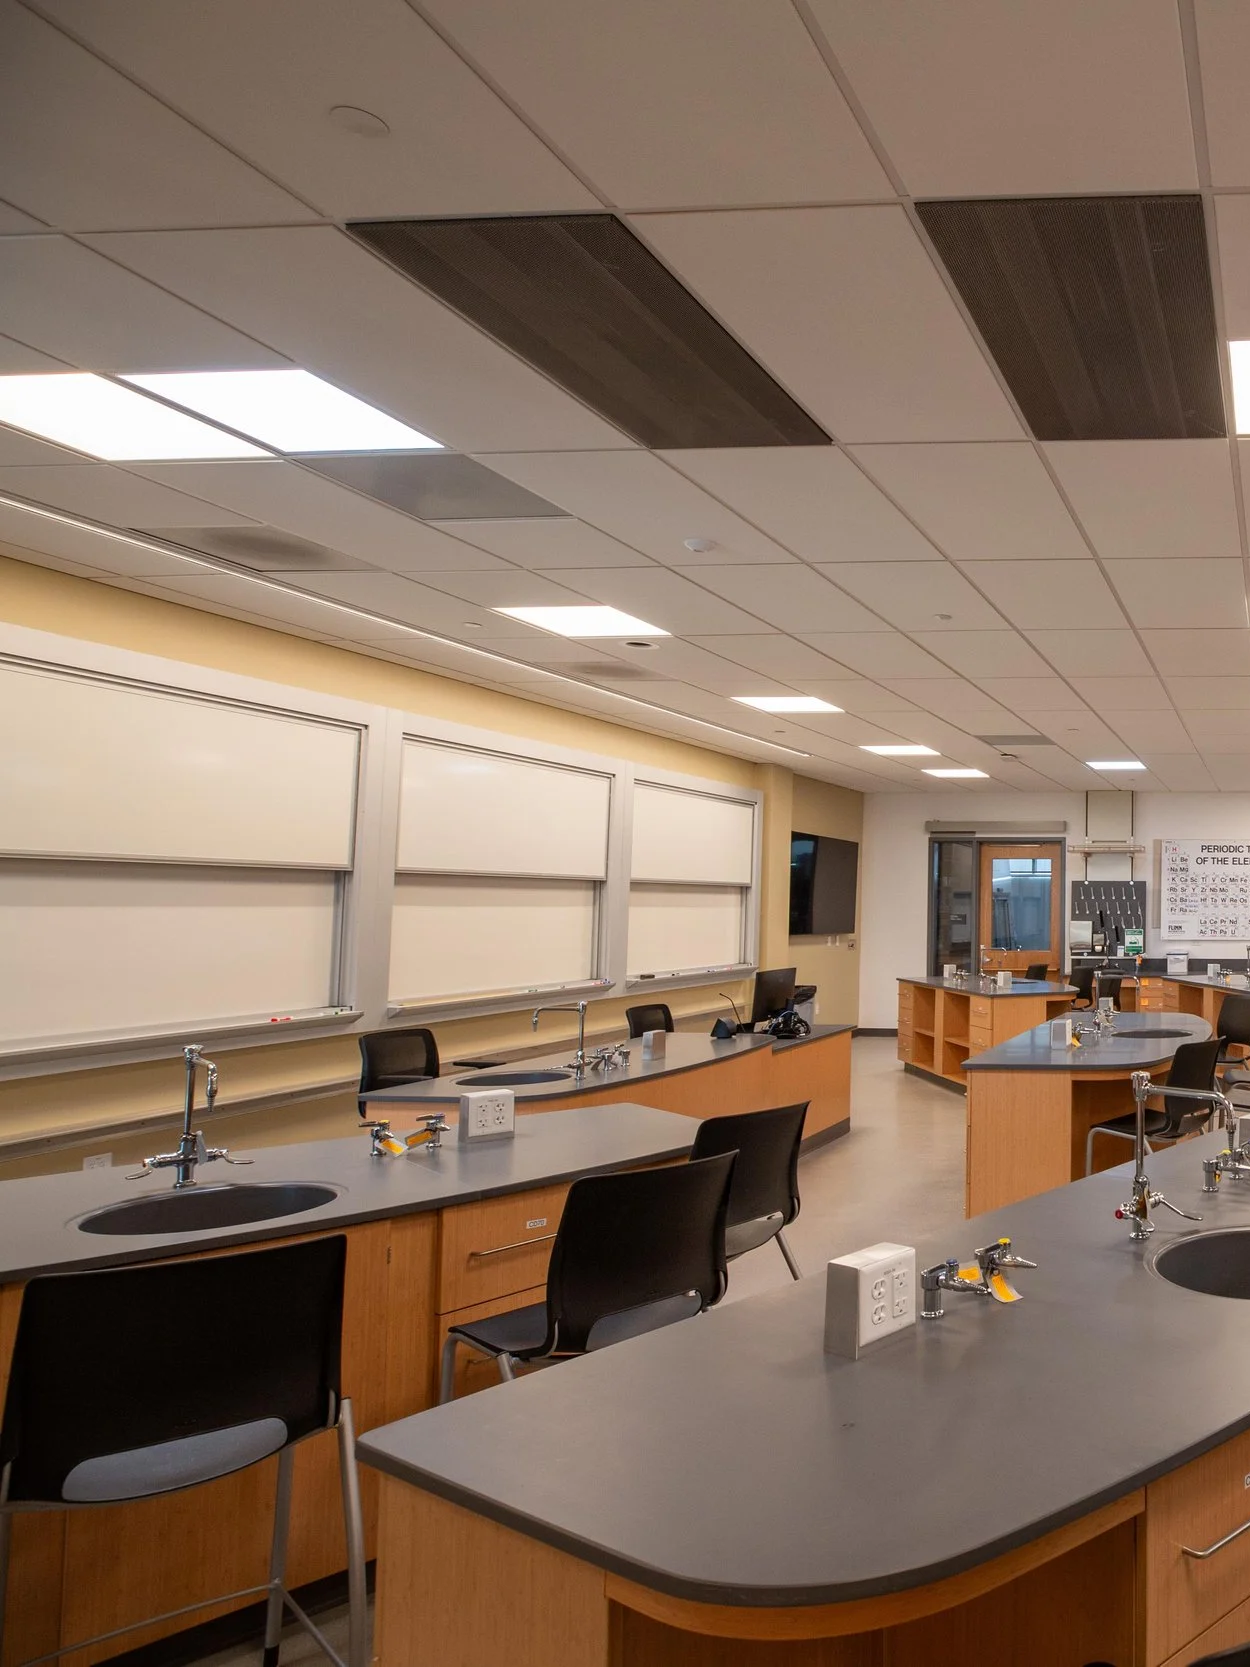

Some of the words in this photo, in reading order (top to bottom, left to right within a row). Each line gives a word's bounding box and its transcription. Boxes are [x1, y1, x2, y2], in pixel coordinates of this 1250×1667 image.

[1201, 845, 1244, 853] PERIODIC
[1195, 857, 1209, 865] OF
[1211, 857, 1229, 865] THE
